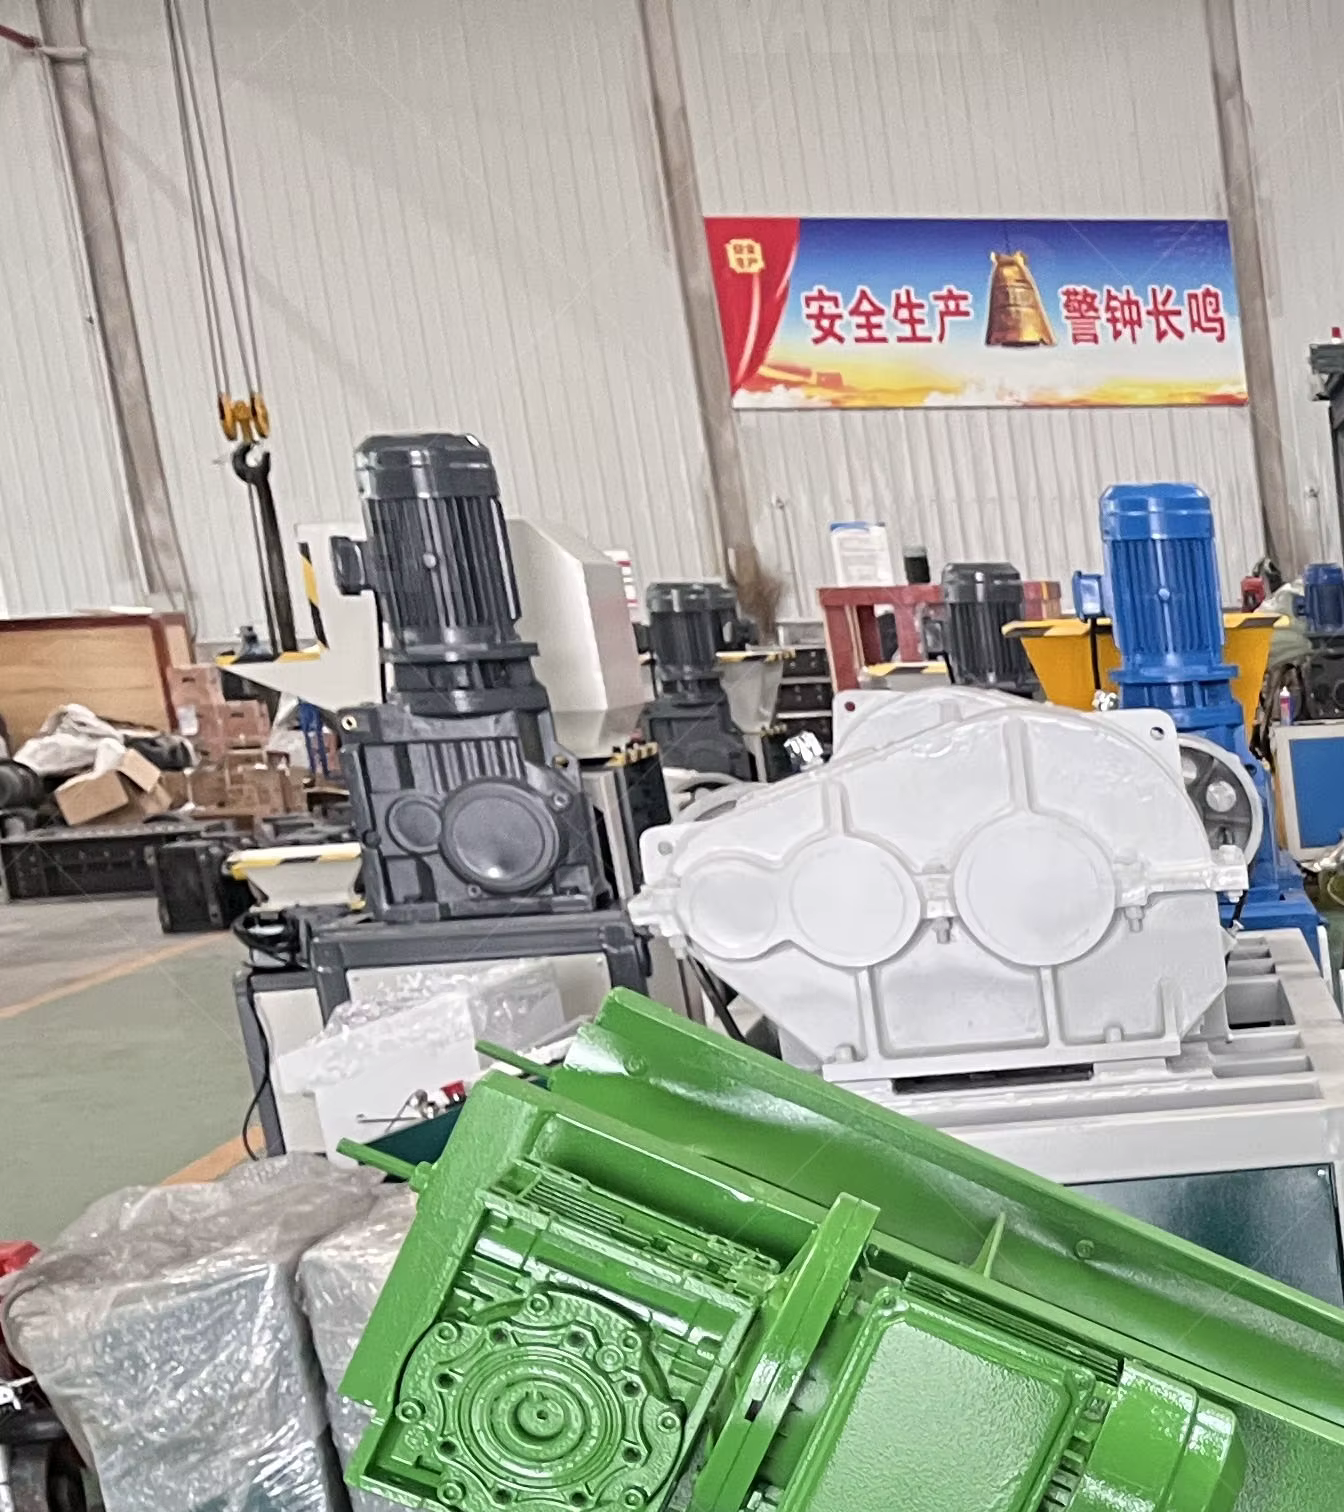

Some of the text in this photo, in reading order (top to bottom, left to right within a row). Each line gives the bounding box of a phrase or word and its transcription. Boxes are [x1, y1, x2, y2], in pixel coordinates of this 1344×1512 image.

[802, 286, 1228, 346] 安全生产 警钟长鸣
